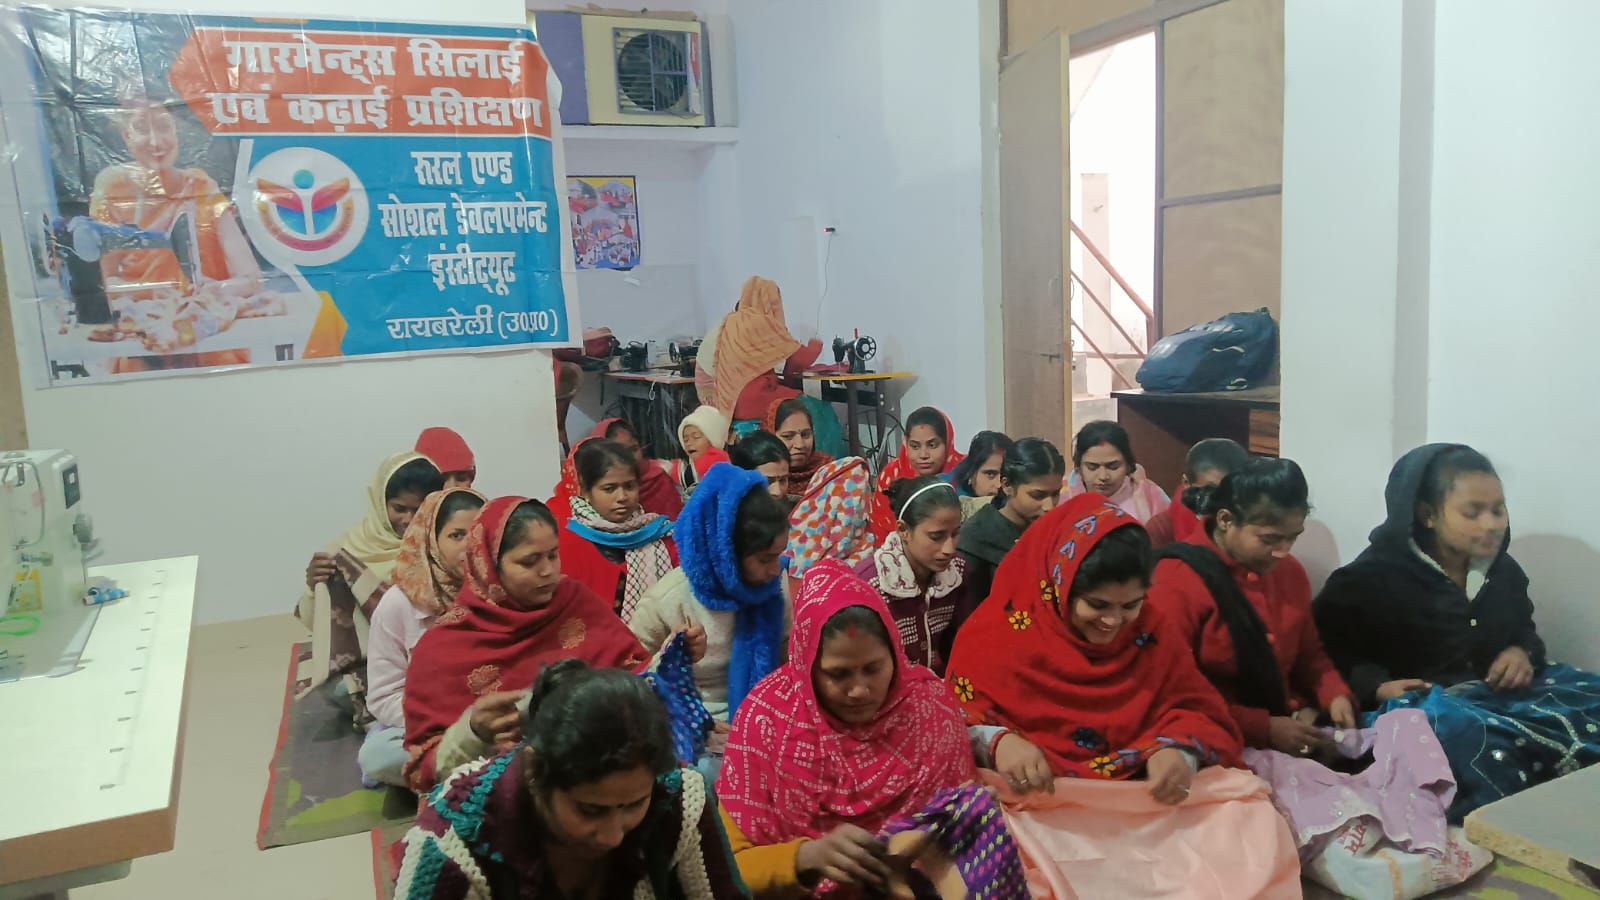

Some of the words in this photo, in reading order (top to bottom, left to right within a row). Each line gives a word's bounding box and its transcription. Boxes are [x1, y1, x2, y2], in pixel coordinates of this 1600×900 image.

[406, 38, 524, 85] सिलाई
[206, 83, 270, 124] एवं
[282, 85, 391, 132] कढ़ाई
[402, 87, 543, 128] प्रशिक्षण
[467, 151, 513, 185] एण्ड
[377, 193, 448, 237] सोशल
[450, 192, 548, 234] डेवलपमेन्ट
[385, 304, 494, 339] रायबरेली
